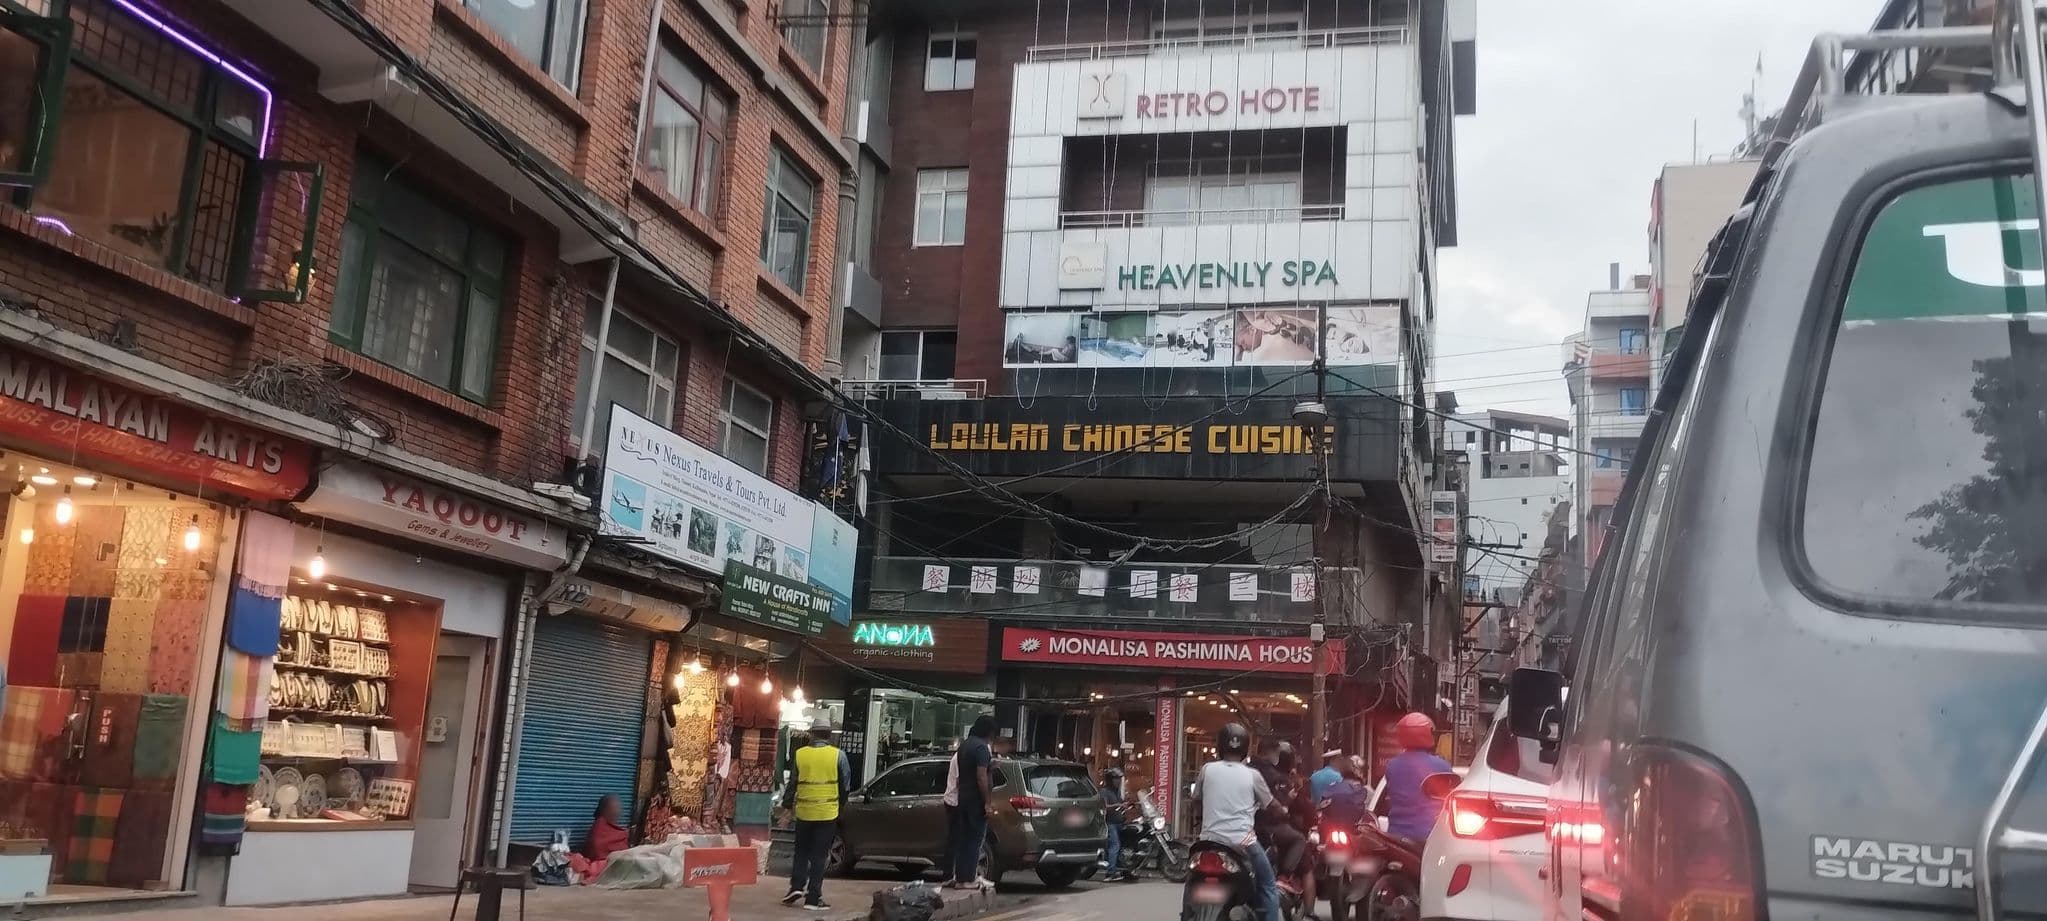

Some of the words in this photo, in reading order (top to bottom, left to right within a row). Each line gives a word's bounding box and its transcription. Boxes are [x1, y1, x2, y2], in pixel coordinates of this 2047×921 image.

[1136, 90, 1229, 119] RETRO
[1118, 262, 1273, 291] HEAVENLY
[1281, 259, 1339, 287] SPA
[50, 419, 81, 434] OF
[930, 423, 1049, 451] LOULAN
[1063, 424, 1192, 453] CHINESE
[194, 419, 283, 474] ARTS
[662, 445, 691, 474] Nexus
[694, 459, 724, 489] Travels
[725, 475, 734, 493] &
[735, 480, 756, 504] Tours
[381, 479, 528, 541] YAQOOT
[407, 519, 437, 536] Gems
[439, 528, 450, 539] &
[449, 532, 491, 552] Jewellery
[743, 574, 771, 596] NEW
[772, 584, 811, 608] CRAFTS
[812, 596, 831, 614] INN
[1050, 637, 1149, 658] MONALISA
[1154, 641, 1253, 662] PASHMINA
[1259, 645, 1313, 664] HOUS
[99, 709, 112, 743] PUSH
[1161, 700, 1171, 742] MONALISA
[1158, 745, 1169, 787] PASHMINA
[1157, 789, 1167, 817] HOUSE
[1814, 837, 1973, 868] MARUT
[1815, 859, 1974, 889] SUZUK
